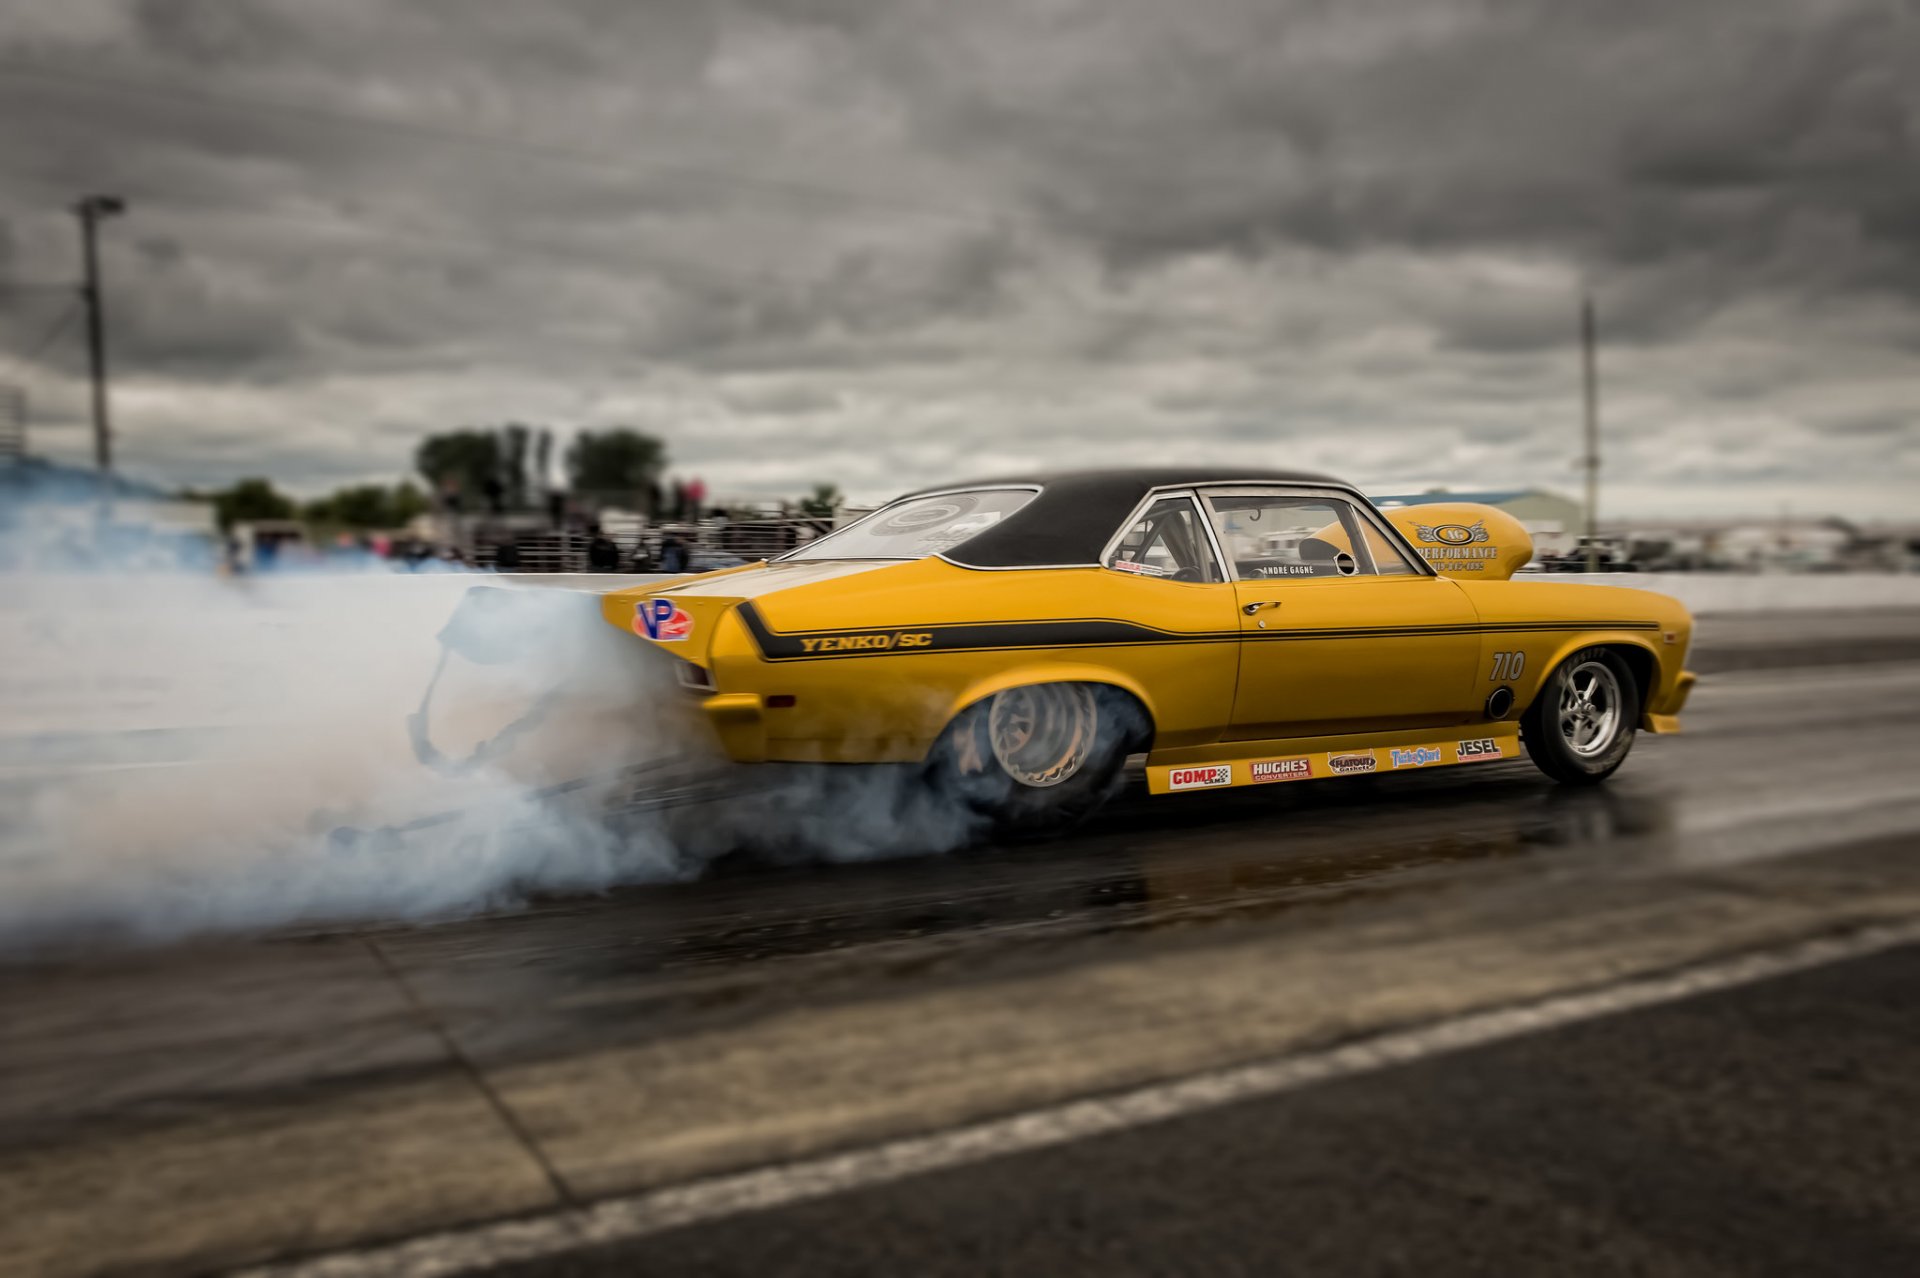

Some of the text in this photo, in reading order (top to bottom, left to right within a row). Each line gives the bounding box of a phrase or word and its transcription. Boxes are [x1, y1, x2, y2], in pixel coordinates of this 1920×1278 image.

[1417, 547, 1497, 559] PERFORMANCE
[636, 599, 673, 640] VP
[801, 632, 933, 652] YENKO/SC
[1490, 652, 1525, 680] 710
[1457, 739, 1499, 755] JESEL
[1253, 759, 1308, 775] HUGHES
[1173, 769, 1217, 784] COMP
[1254, 771, 1309, 781] CONVERTERS
